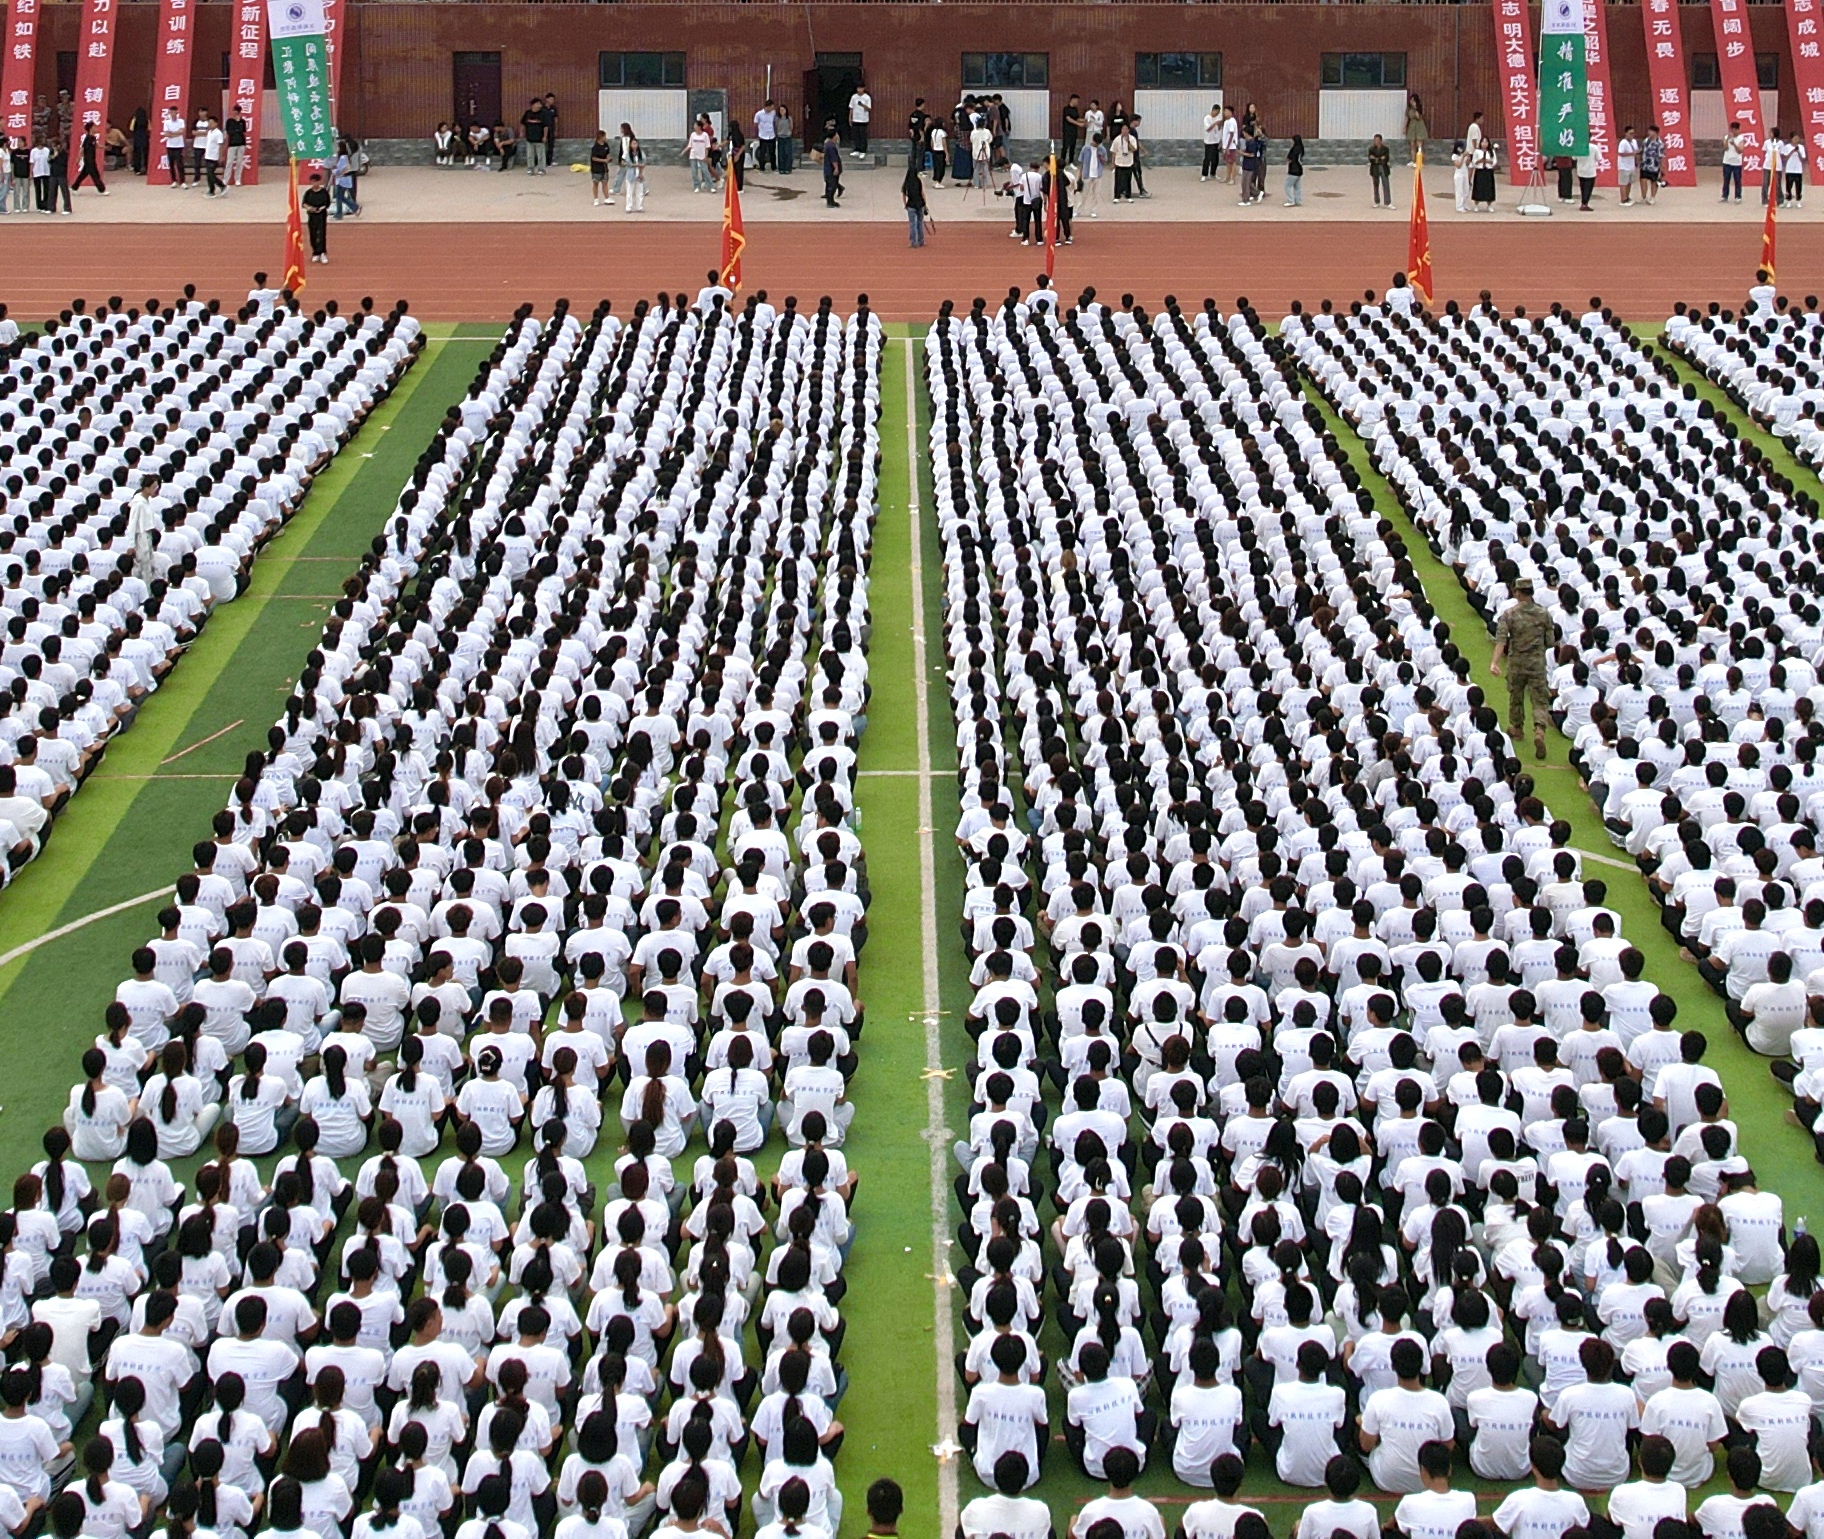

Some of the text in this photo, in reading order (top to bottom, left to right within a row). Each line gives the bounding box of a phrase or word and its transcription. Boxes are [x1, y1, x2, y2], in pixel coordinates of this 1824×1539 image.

[1503, 23, 1526, 68] 明大德
[1510, 75, 1530, 118] 成大才
[1557, 40, 1575, 147] 精准严好
[1514, 125, 1535, 171] 担大任
[1659, 88, 1687, 171] 逐梦扬威
[1733, 87, 1762, 171] 意气风发
